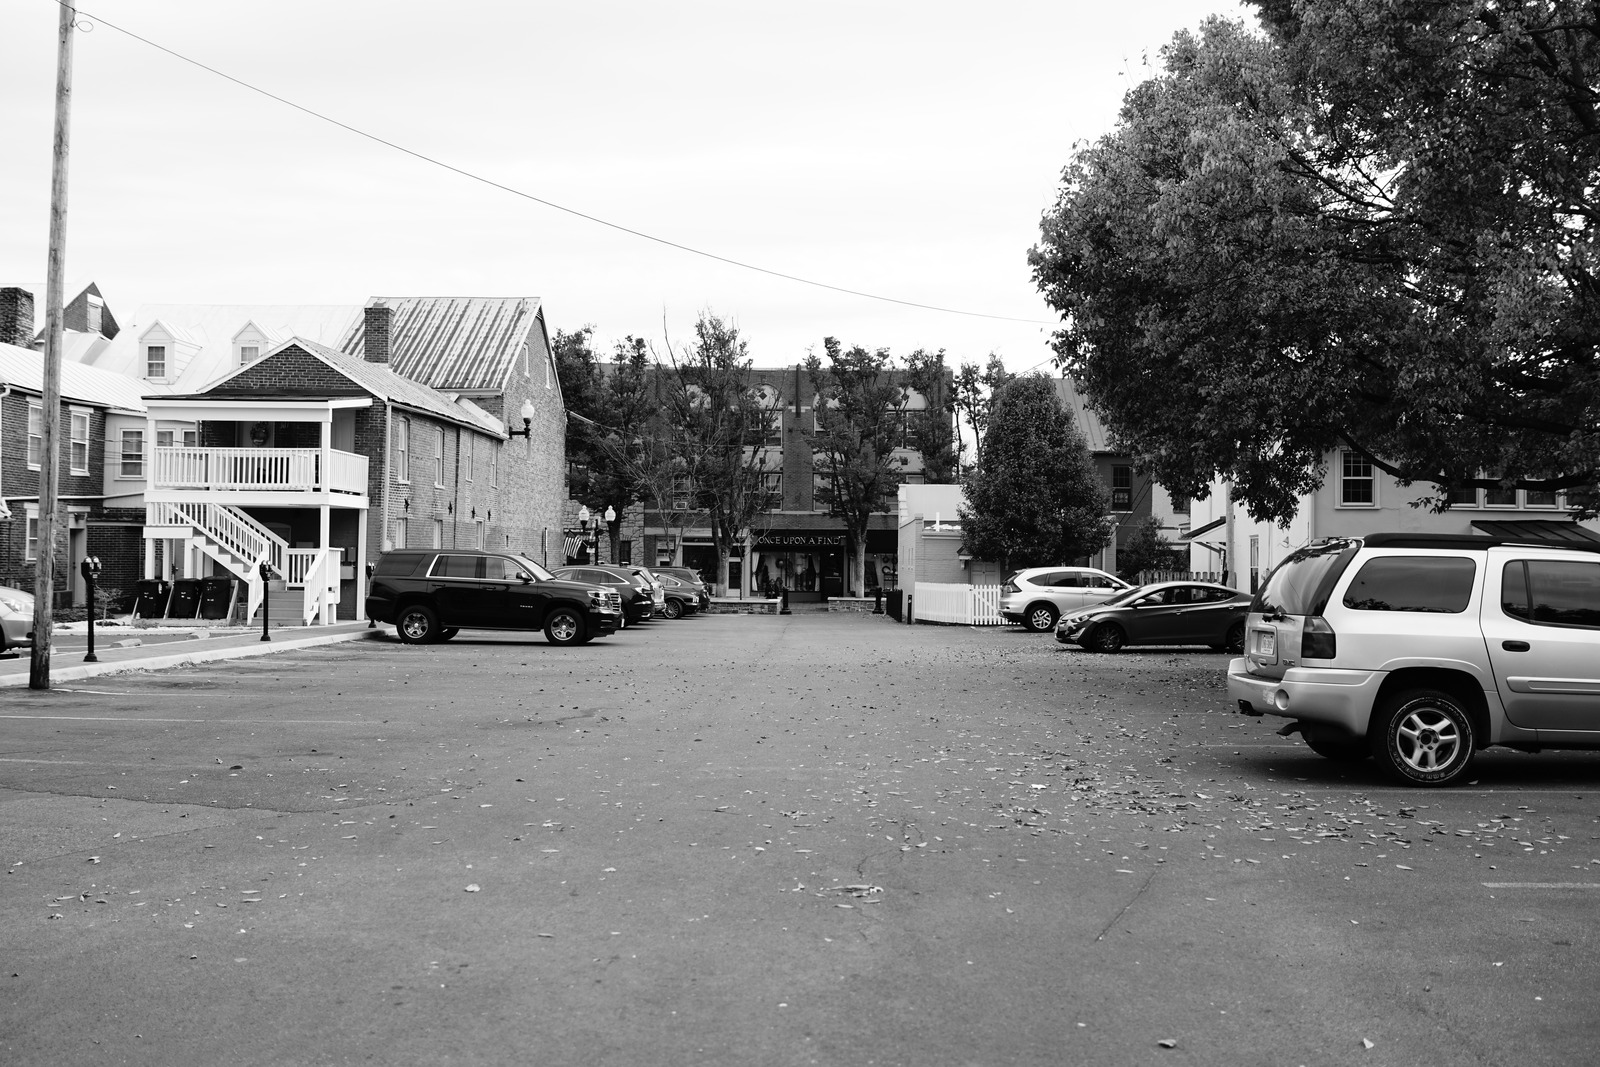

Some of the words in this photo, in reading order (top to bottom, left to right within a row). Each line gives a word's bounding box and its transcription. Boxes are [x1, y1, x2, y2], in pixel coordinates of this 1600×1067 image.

[758, 536, 780, 544] ONCE
[783, 536, 806, 544] UPON
[808, 536, 816, 544] A
[818, 536, 840, 544] FIND
